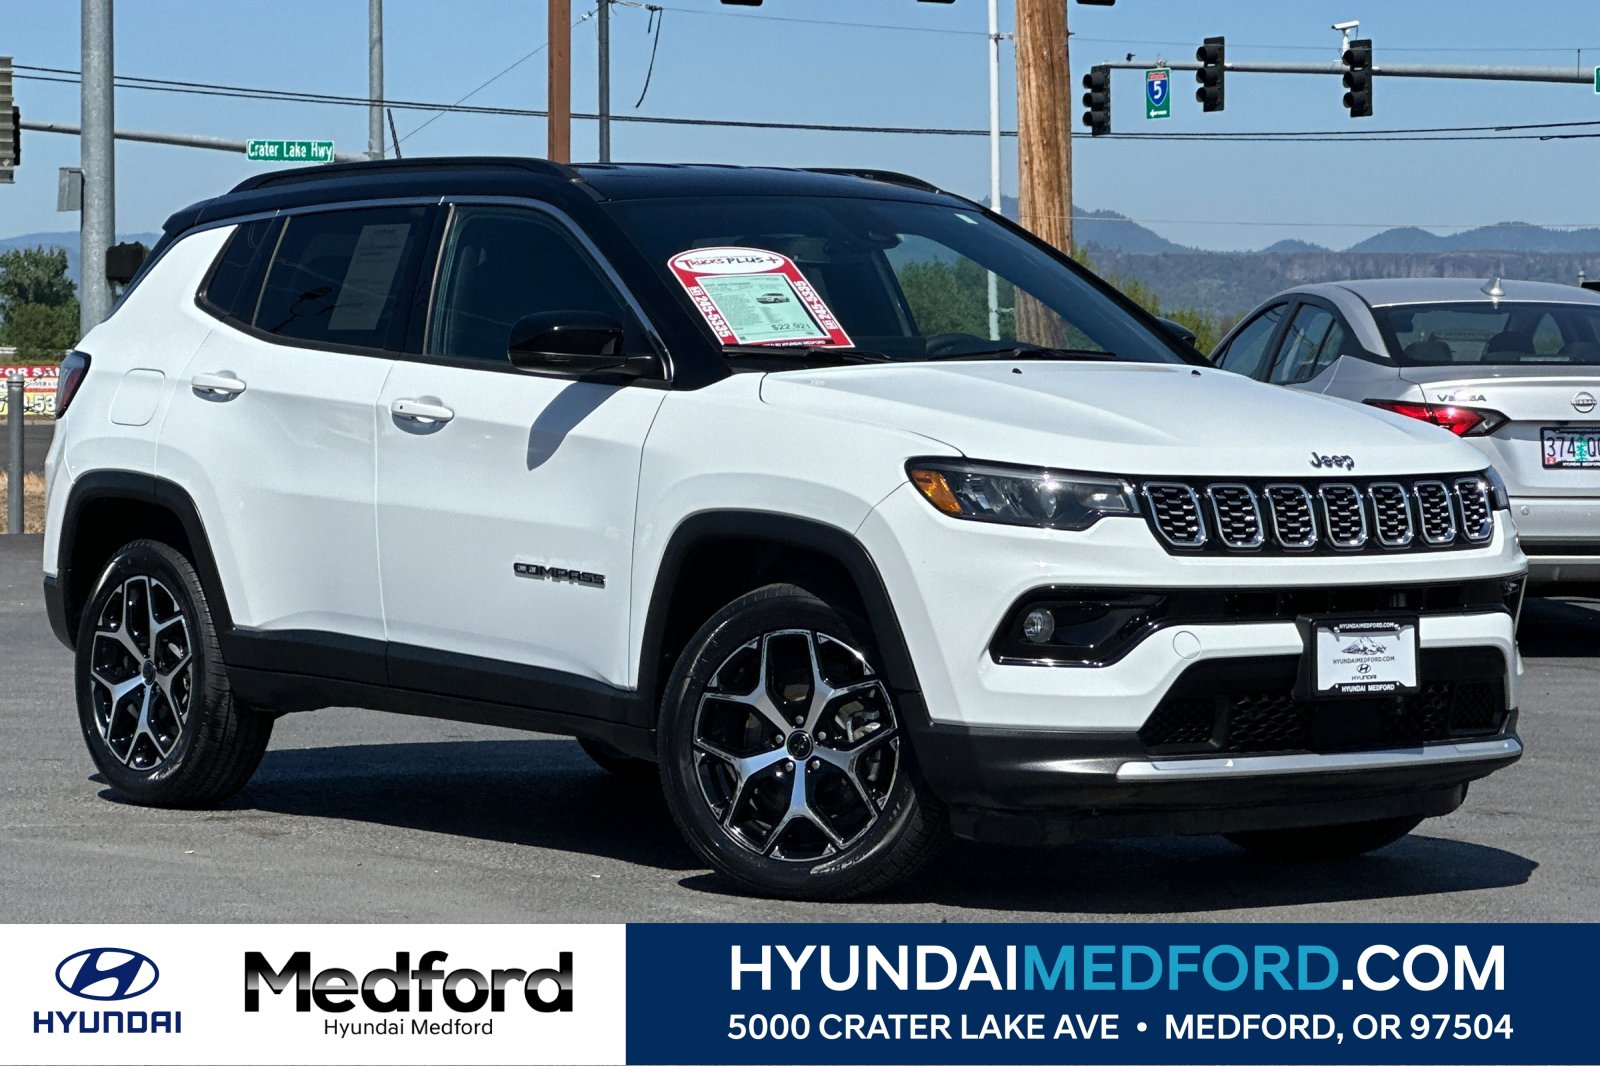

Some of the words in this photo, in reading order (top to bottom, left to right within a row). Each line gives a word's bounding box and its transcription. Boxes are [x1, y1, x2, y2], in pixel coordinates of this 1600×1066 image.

[1153, 80, 1162, 99] 5
[248, 141, 278, 157] Crater
[283, 141, 307, 158] Lake
[310, 142, 333, 162] Hwy
[1545, 437, 1576, 457] 374
[1309, 452, 1355, 471] Jeep
[513, 562, 606, 587] COMPASS
[1333, 656, 1395, 664] HYUNDAIMEDFORD.COM
